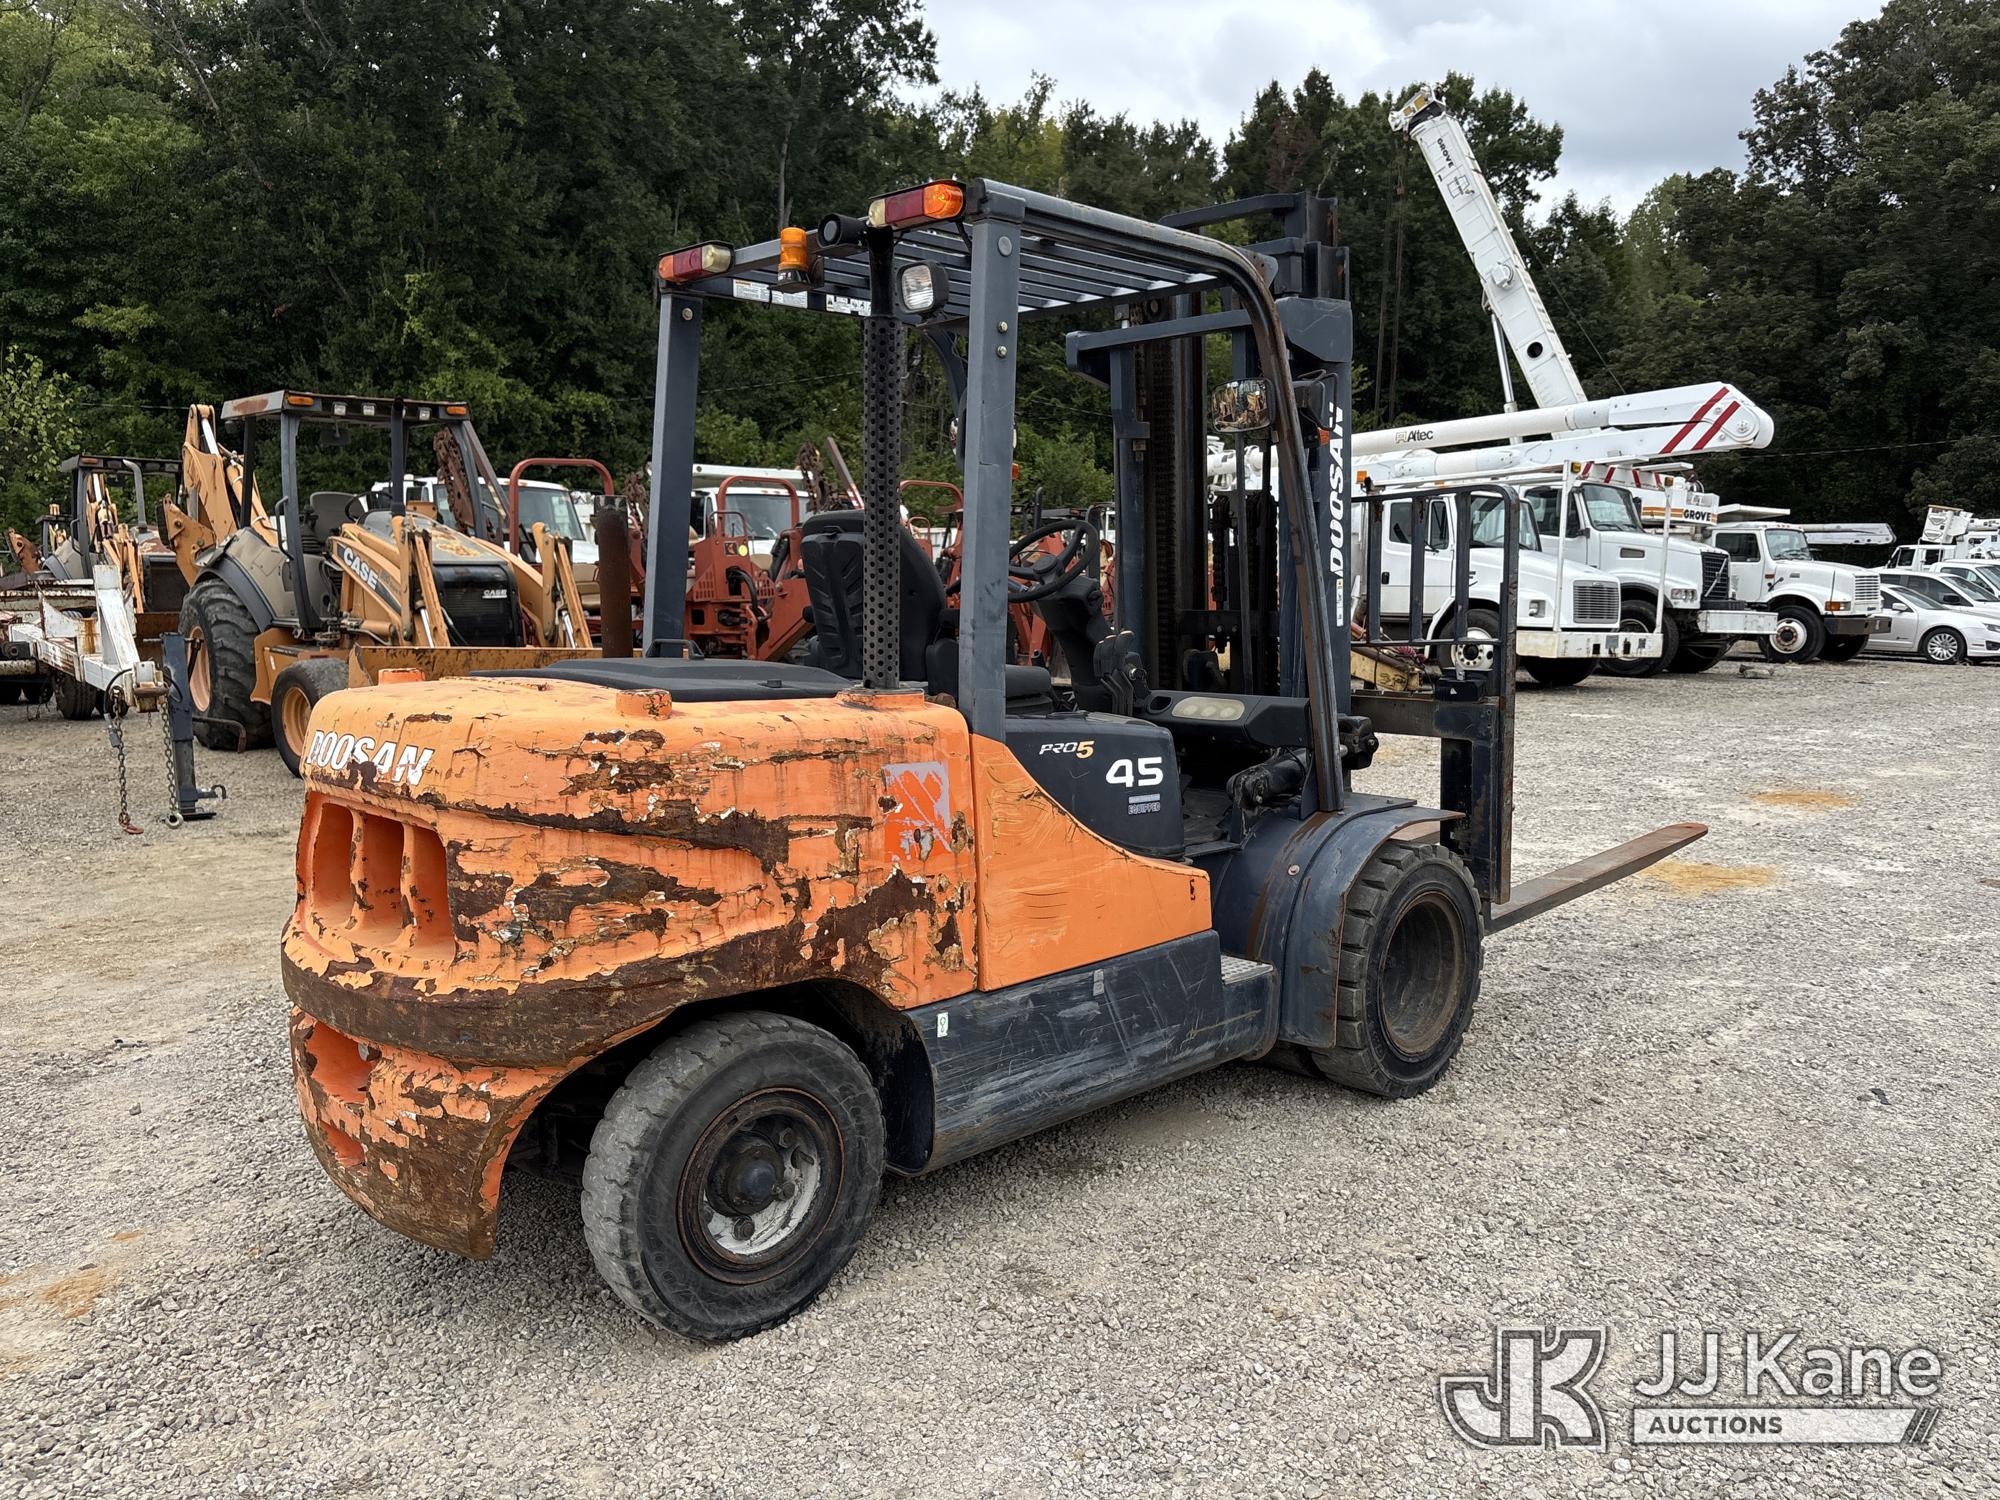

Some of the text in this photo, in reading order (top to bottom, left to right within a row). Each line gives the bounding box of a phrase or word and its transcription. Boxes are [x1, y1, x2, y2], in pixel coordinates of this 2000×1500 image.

[1407, 430, 1434, 442] Altec
[1684, 510, 1712, 521] GROVE
[343, 547, 379, 590] CASE
[1105, 756, 1164, 788] 45
